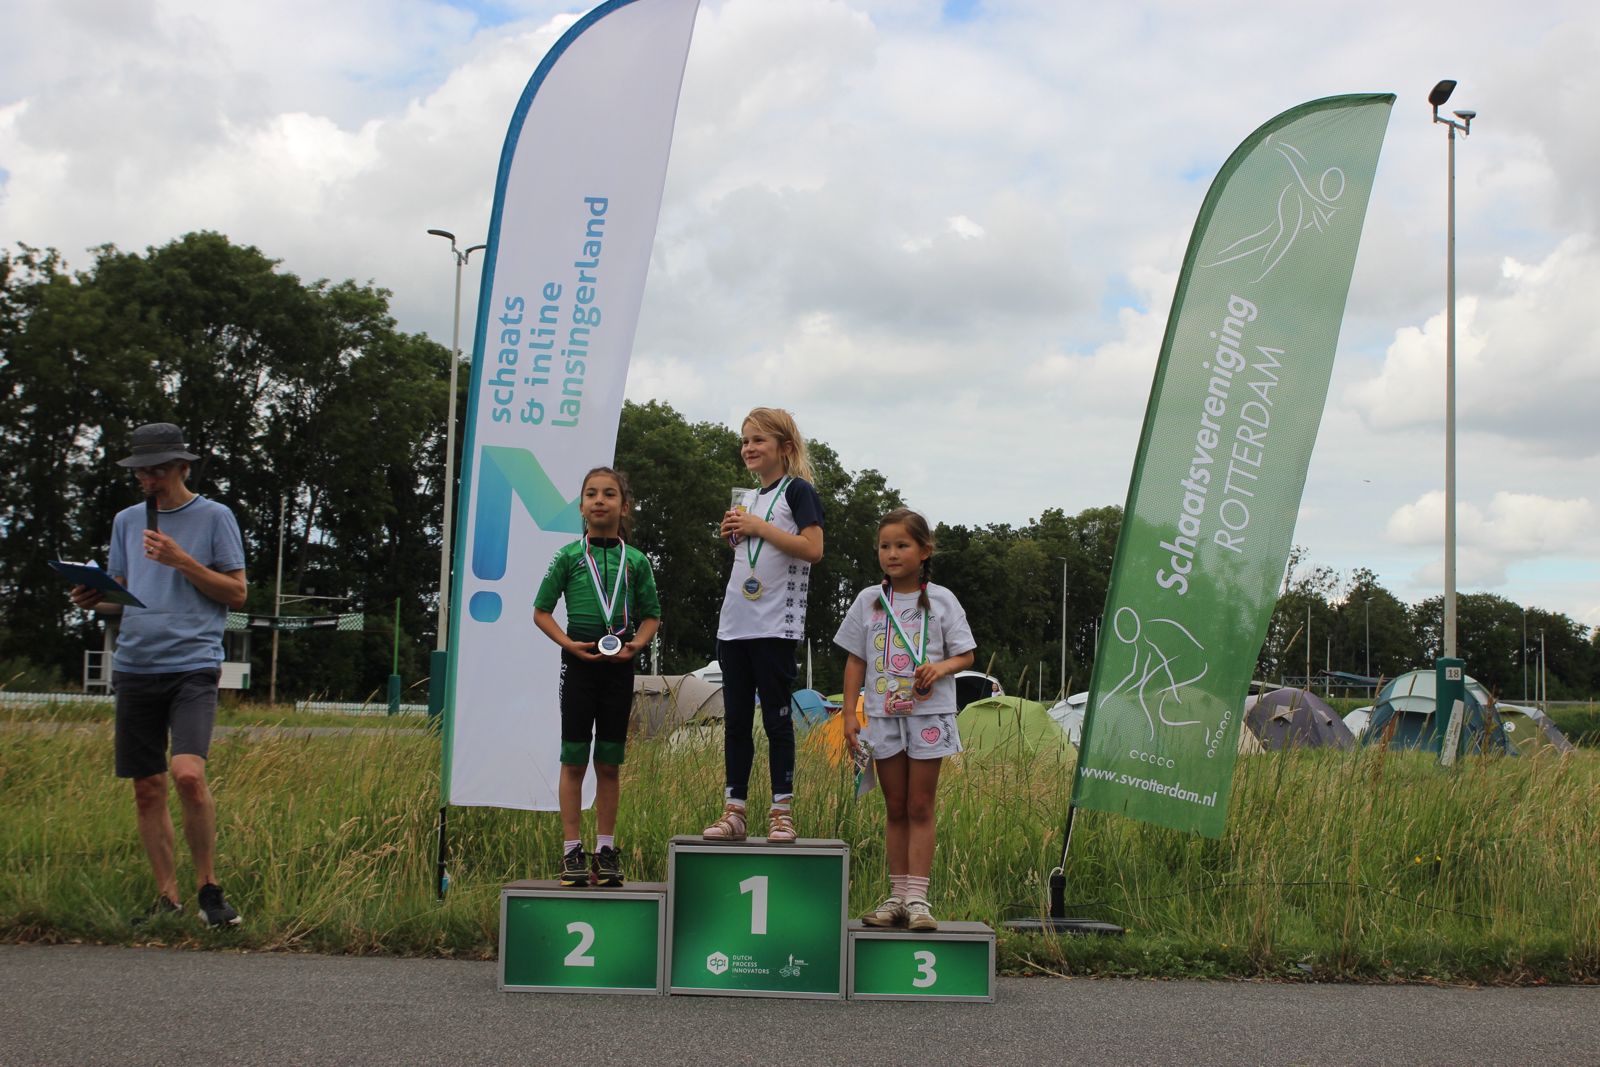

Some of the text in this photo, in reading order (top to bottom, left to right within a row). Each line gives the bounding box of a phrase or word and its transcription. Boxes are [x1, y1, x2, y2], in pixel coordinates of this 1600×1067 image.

[519, 281, 562, 426] & inline
[551, 195, 609, 429] lansingerland
[488, 295, 525, 425] schaats
[1156, 294, 1258, 596] Schaatsvereniging
[1213, 344, 1285, 555] ROTTERDAM
[1447, 669, 1459, 678] 18
[1080, 766, 1217, 808] www.svrotterdam.nl
[563, 921, 596, 967] 2
[738, 875, 769, 935] 1
[912, 950, 938, 988] 3
